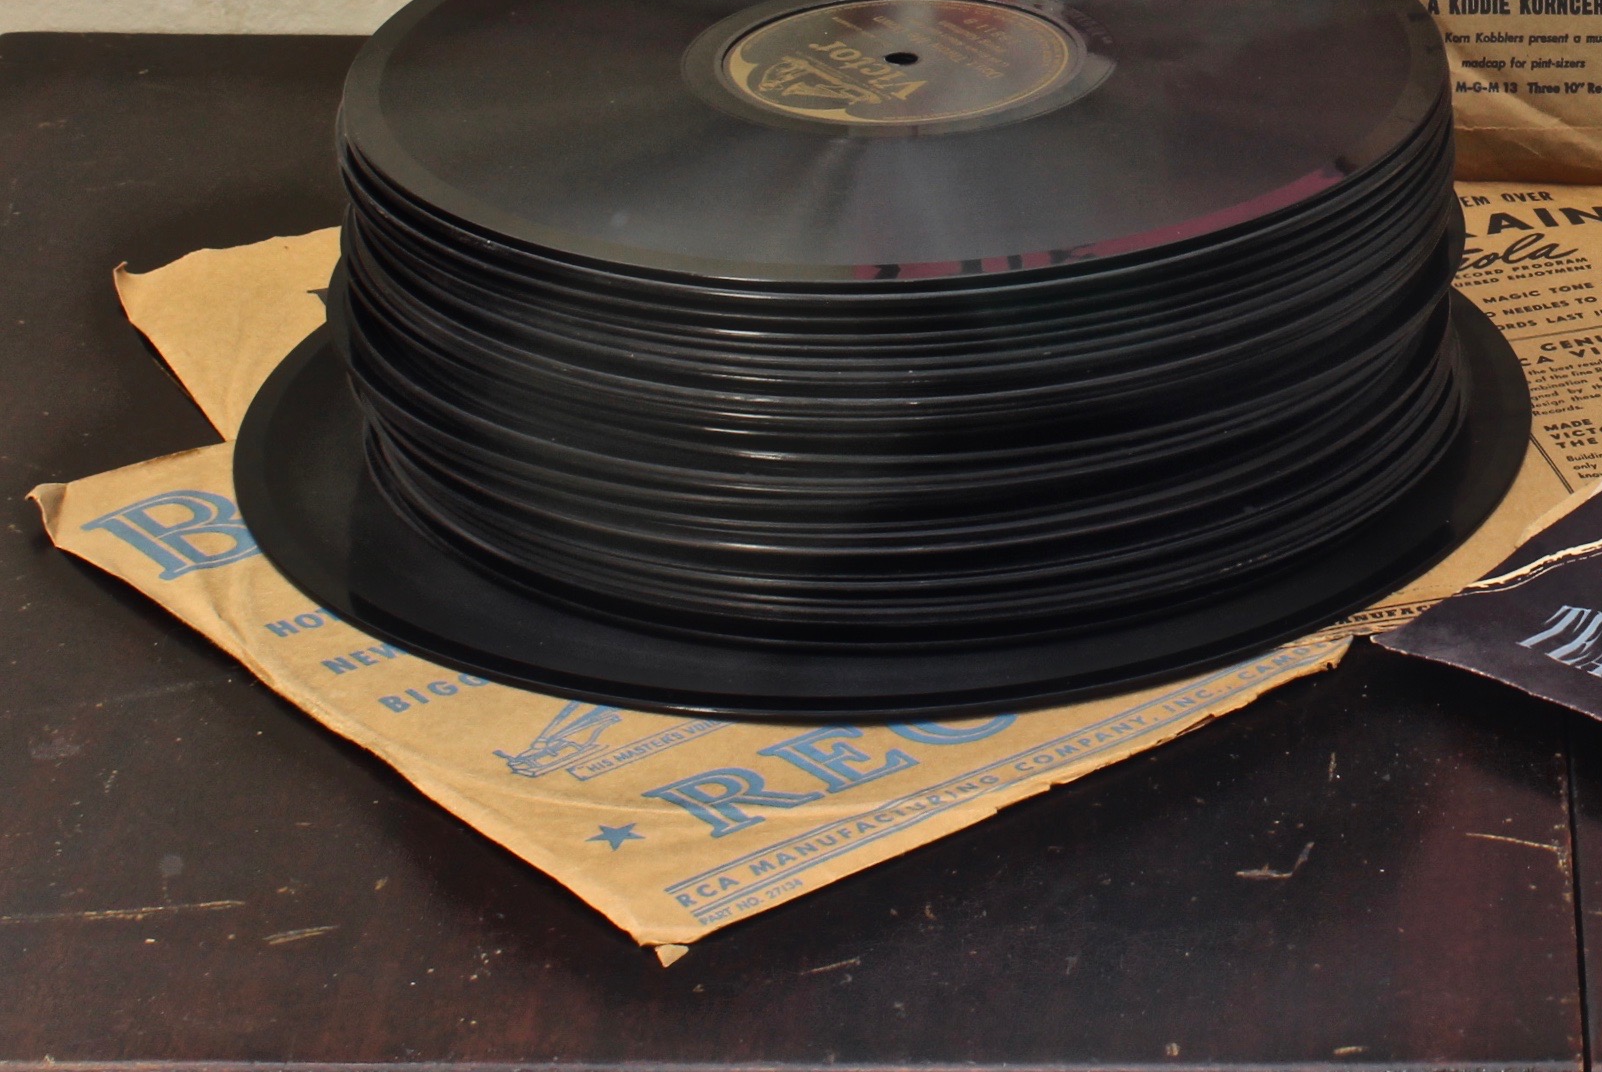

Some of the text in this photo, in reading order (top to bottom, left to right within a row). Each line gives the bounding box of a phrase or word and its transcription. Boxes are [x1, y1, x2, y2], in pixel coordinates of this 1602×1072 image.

[1500, 190, 1555, 204] OVER
[1506, 264, 1593, 281] ENJOYMENT
[1512, 256, 1589, 274] PROGRAM
[1482, 289, 1542, 305] MAGIC
[1548, 281, 1595, 295] TONE
[1502, 299, 1570, 318] NEEDLES
[1574, 295, 1598, 305] TO
[1545, 312, 1585, 325] LAST
[1542, 418, 1593, 432] MADE
[675, 875, 741, 909] RCA
[748, 774, 1001, 878] MANUFACTURING
